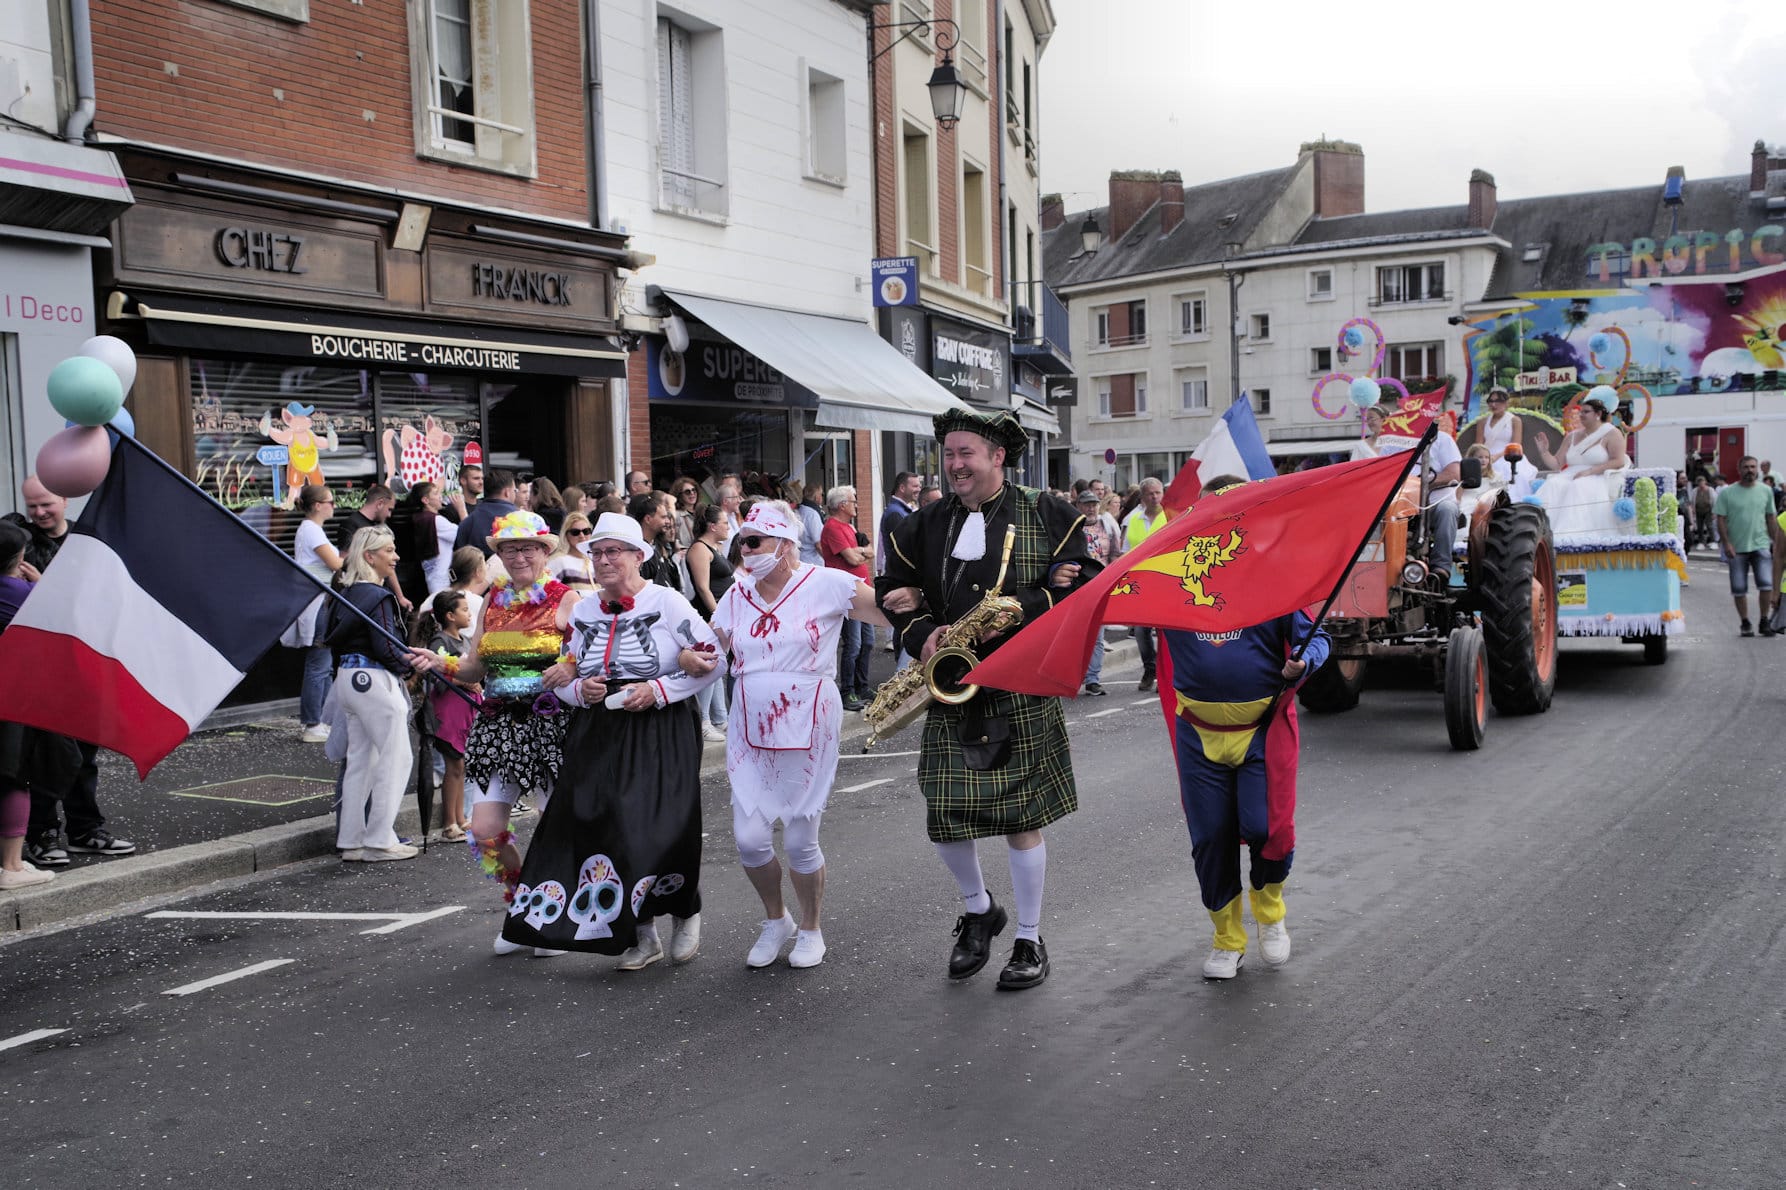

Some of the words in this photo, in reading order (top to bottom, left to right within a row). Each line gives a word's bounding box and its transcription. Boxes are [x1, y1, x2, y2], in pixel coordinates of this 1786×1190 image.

[217, 227, 306, 274] CHEZ
[872, 258, 915, 269] SUPERETTE
[1586, 225, 1785, 282] TROPIC
[473, 261, 571, 306] FRANCK
[21, 296, 83, 323] Deco
[311, 335, 407, 362] BOUCHERIE
[422, 345, 521, 370] CHARCUTERIE
[937, 336, 958, 363] BRAY
[959, 341, 993, 370] COIFFURE
[262, 450, 287, 461] ROUEN
